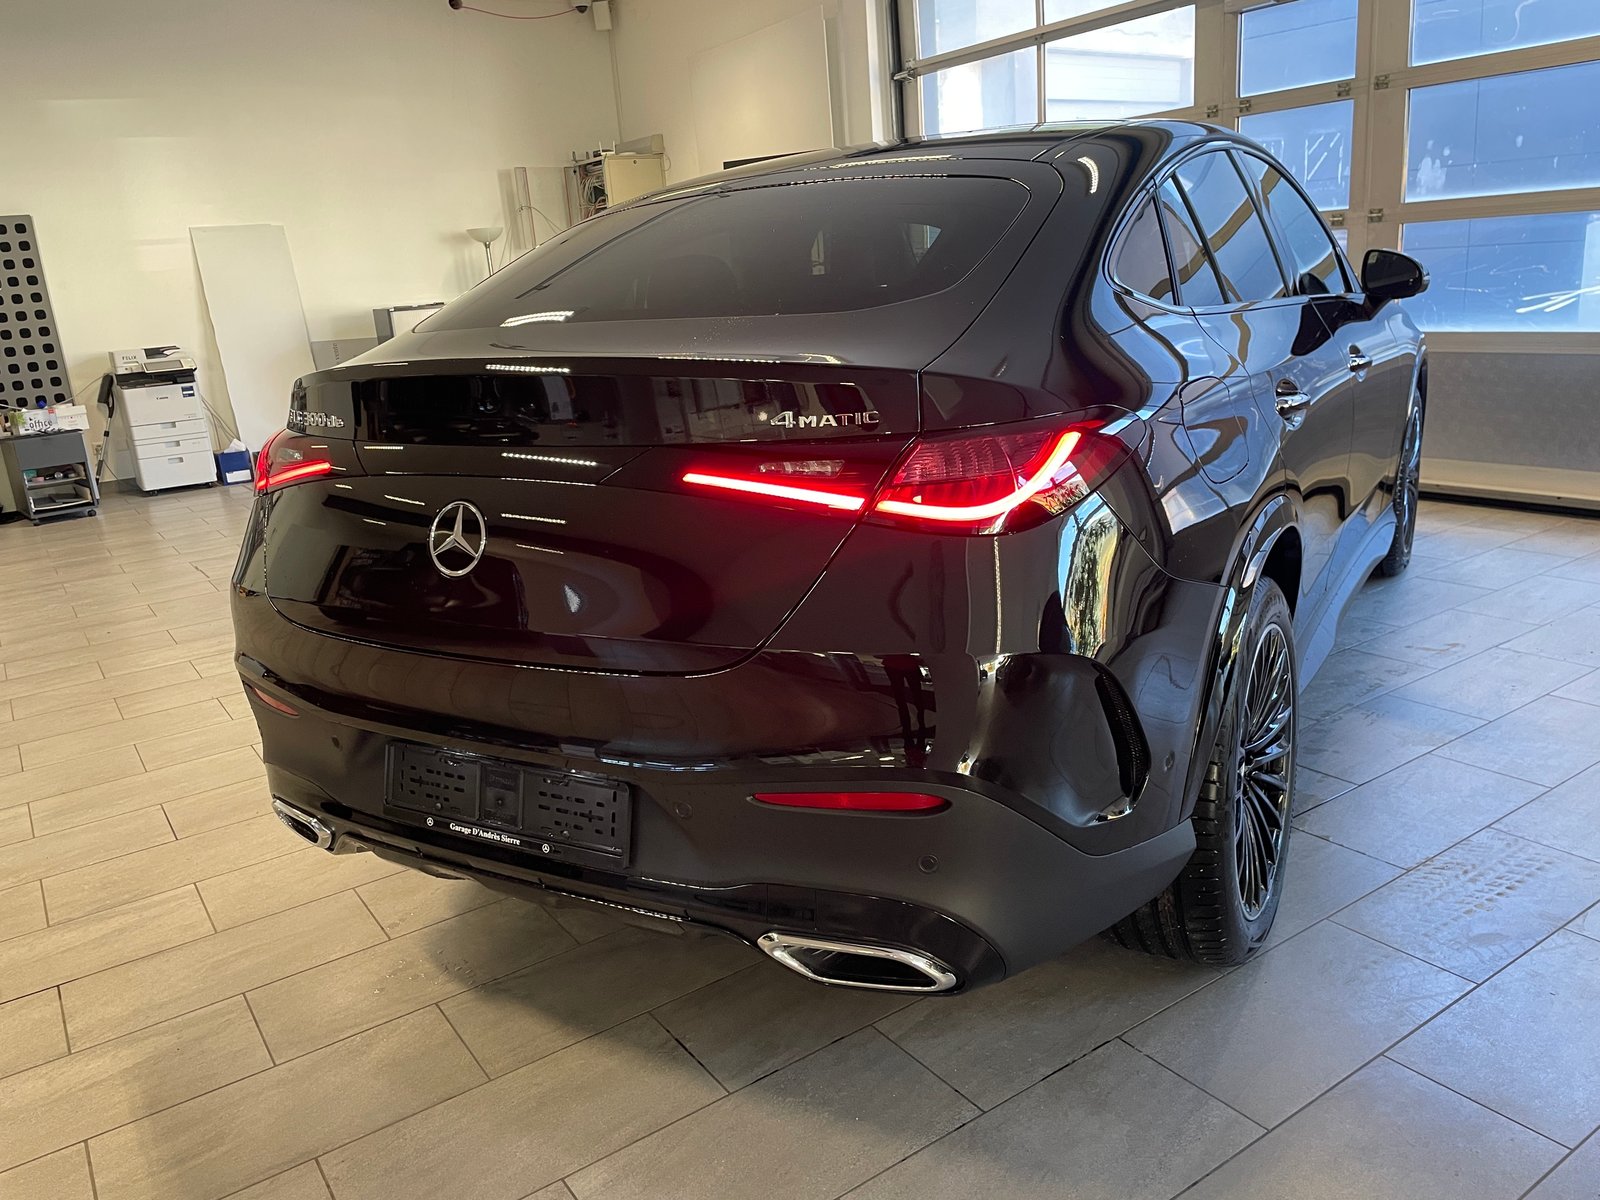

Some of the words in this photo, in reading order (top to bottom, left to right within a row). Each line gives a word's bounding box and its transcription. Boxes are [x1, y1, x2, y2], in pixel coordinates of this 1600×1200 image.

[29, 419, 53, 429] office
[770, 411, 879, 428] 4MATIC
[449, 822, 472, 835] Garage
[472, 827, 500, 841] D'Andrès
[500, 834, 521, 846] Sierre
